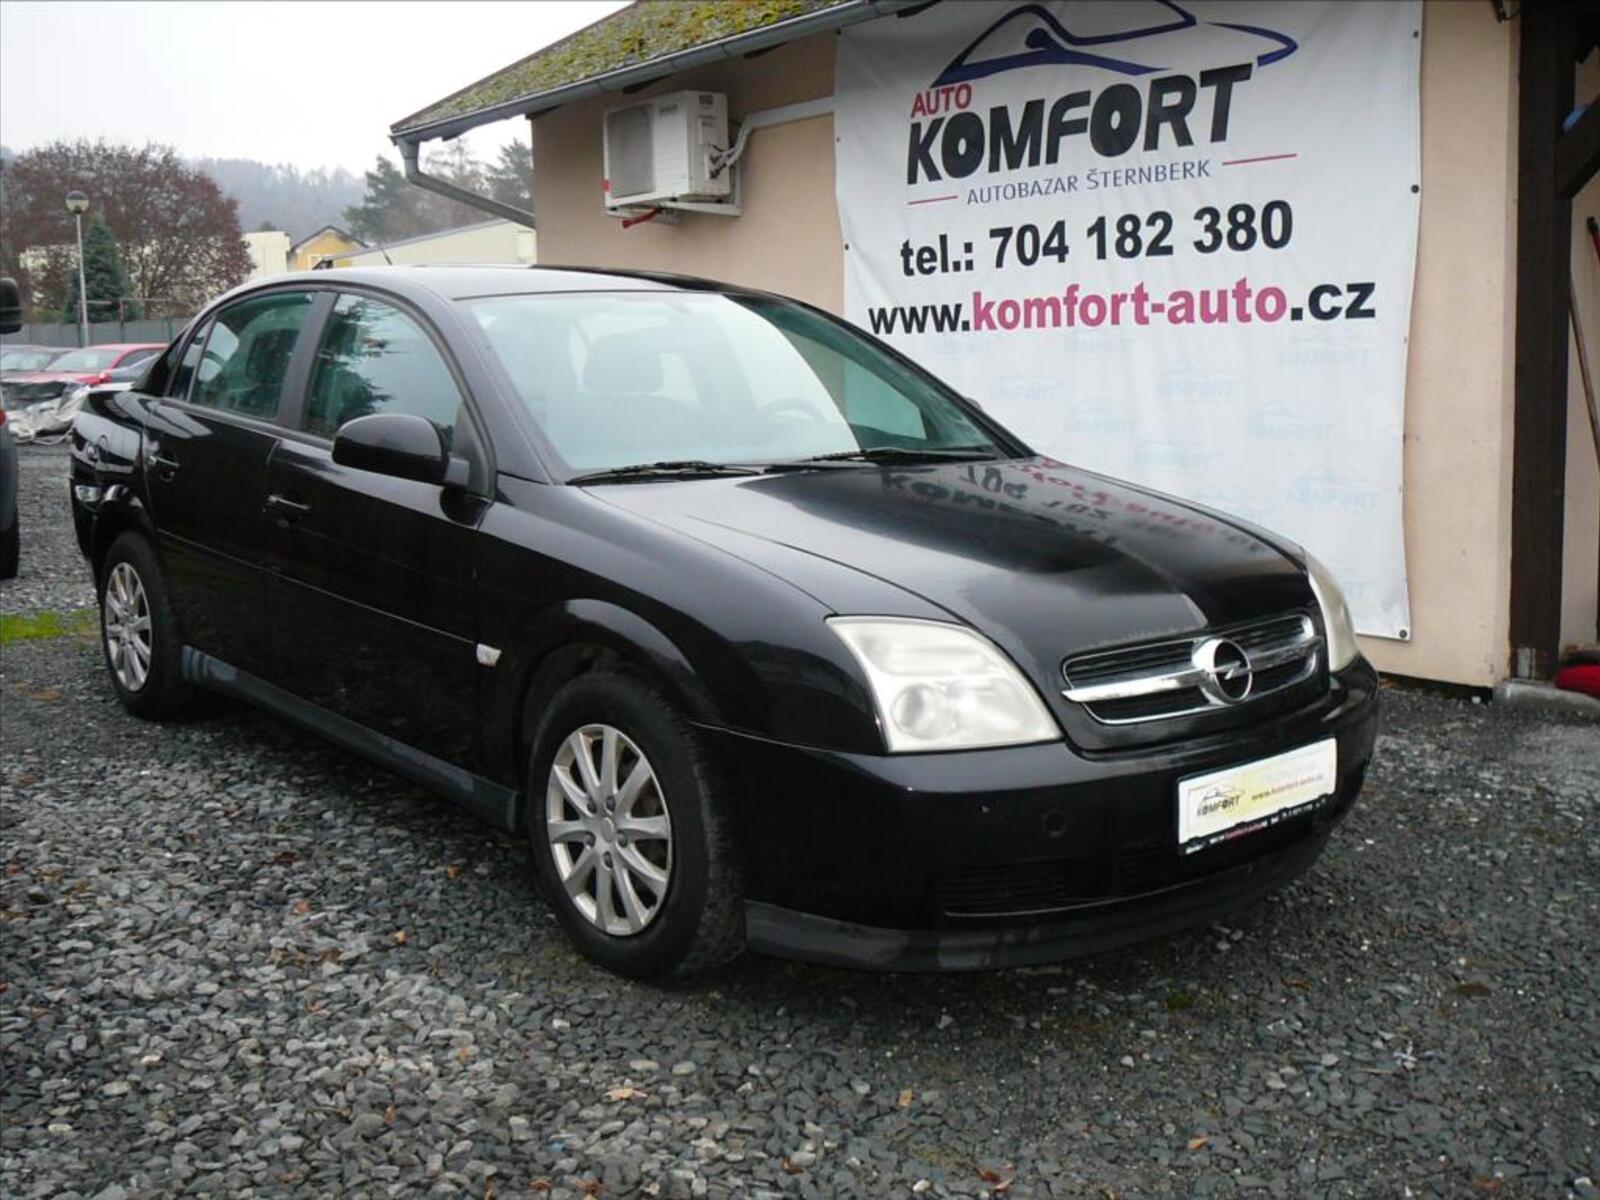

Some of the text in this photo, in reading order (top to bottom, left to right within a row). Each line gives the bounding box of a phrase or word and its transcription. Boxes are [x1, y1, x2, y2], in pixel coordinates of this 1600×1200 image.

[907, 63, 1253, 185] KOMFORT
[911, 84, 973, 118] AUTO
[967, 159, 1211, 205] AUTOBAZAR ŠTERNBERK
[900, 200, 1293, 277] tel.: 704 182 380
[868, 277, 1376, 335] www.komfort-auto.cz
